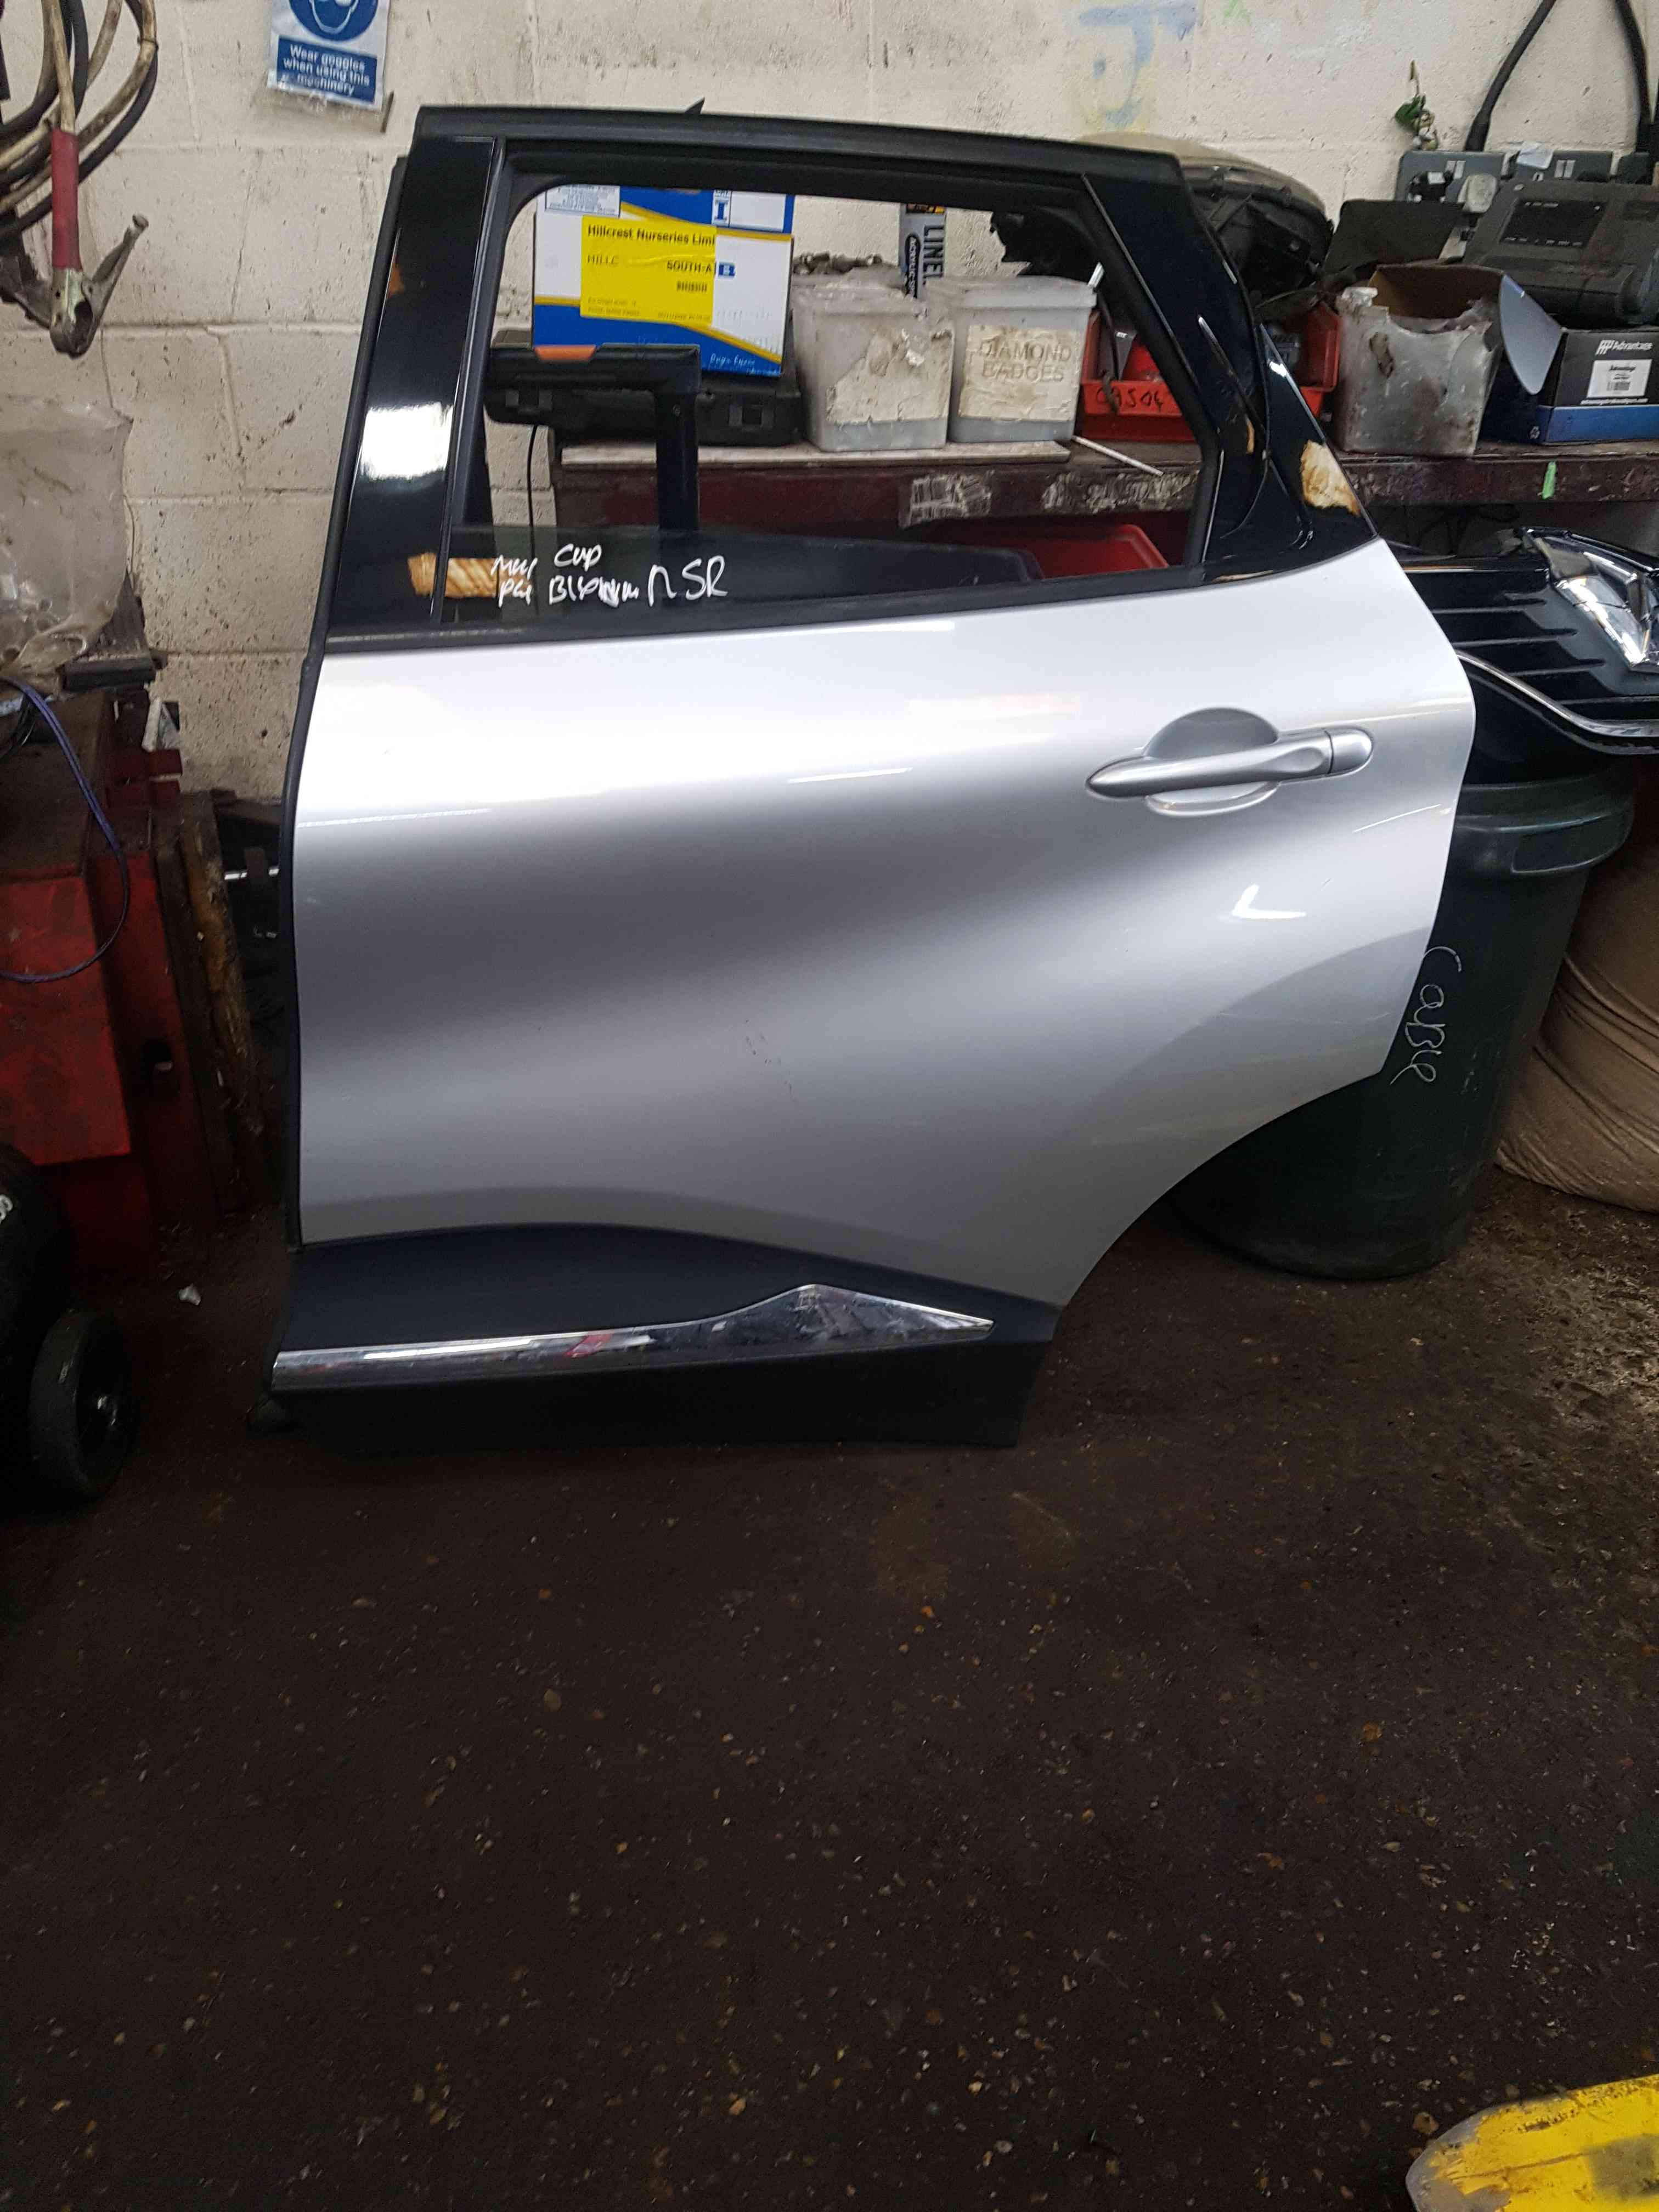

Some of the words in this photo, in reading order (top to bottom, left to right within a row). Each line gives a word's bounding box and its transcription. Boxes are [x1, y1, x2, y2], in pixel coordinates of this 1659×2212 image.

[290, 44, 318, 60] Wear
[321, 54, 365, 71] goggles
[283, 57, 313, 74] when
[316, 65, 347, 81] using
[349, 70, 370, 87] this
[588, 225, 633, 238] Hillcrest
[637, 228, 690, 243] Nurseries
